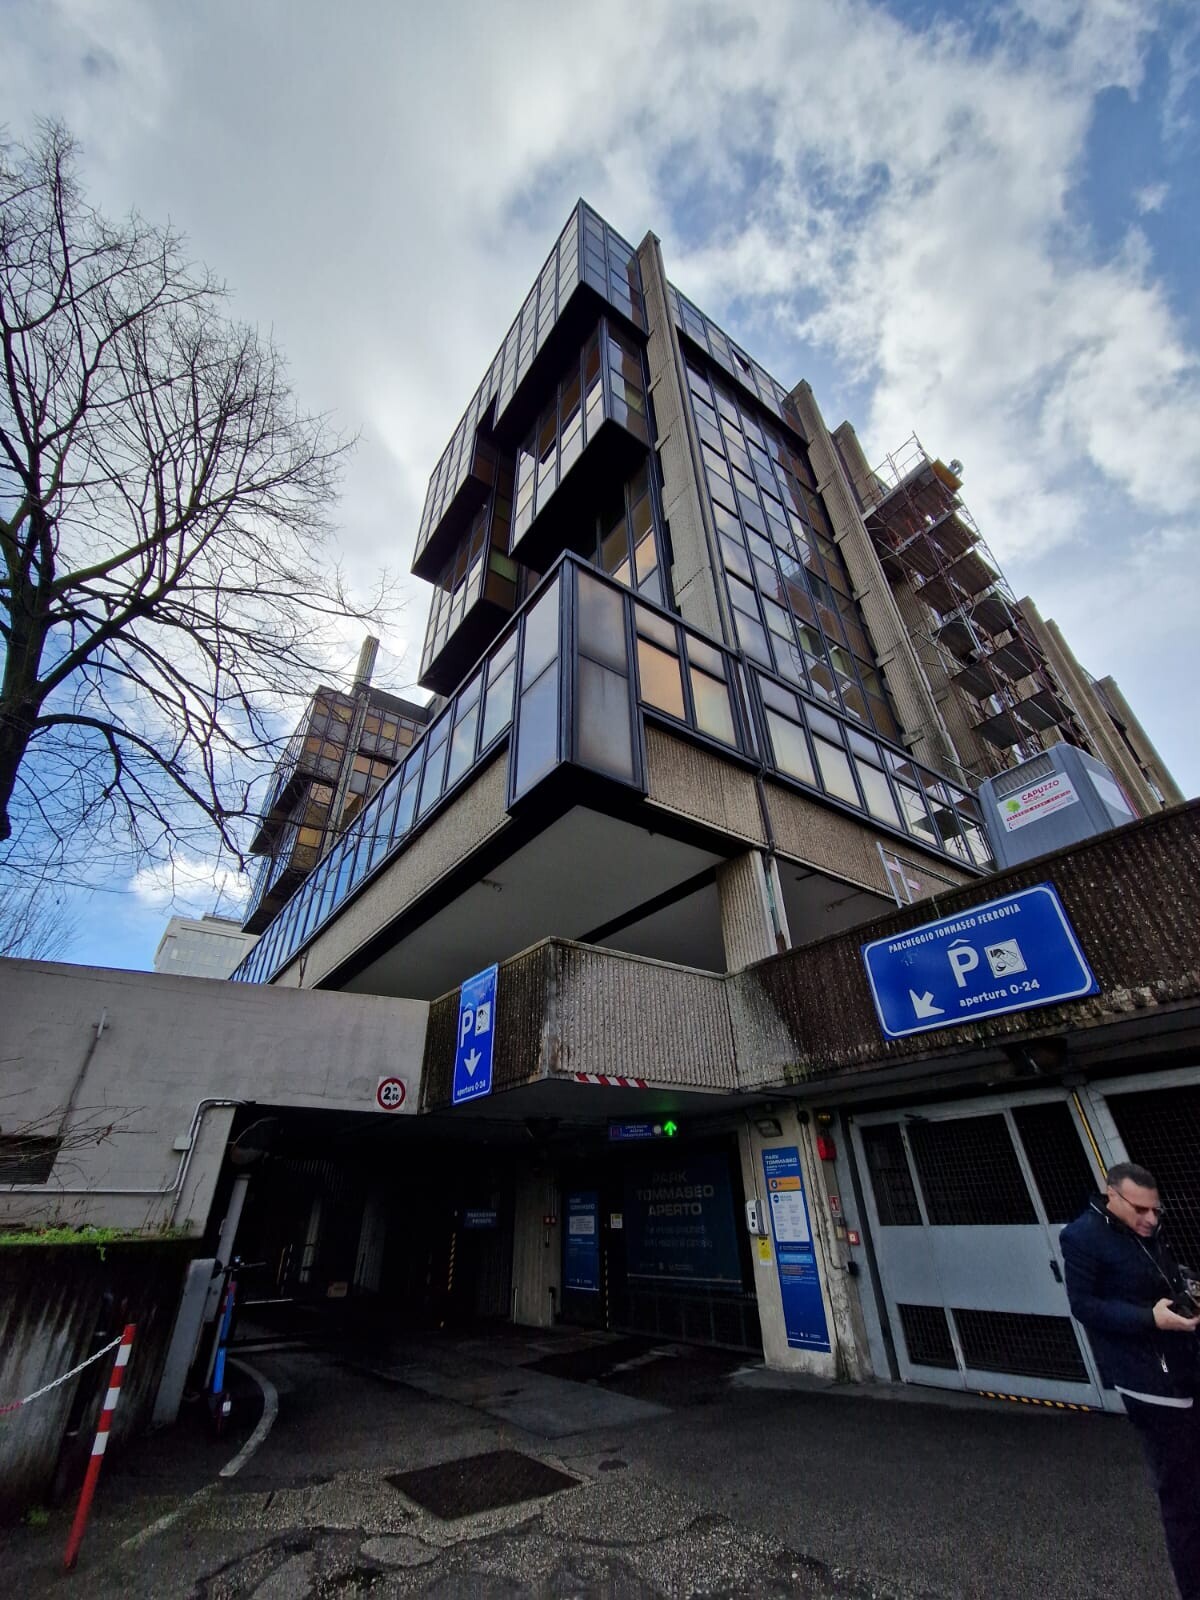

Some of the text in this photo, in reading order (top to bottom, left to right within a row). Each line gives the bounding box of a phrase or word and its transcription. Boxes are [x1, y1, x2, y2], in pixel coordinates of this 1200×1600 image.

[1021, 780, 1060, 801] CAPUZZO
[888, 903, 1021, 954] PARCHEGGIO TOMMASEO FERROVIA
[947, 944, 979, 988] P
[959, 978, 1040, 1008] apertura 0-24
[460, 1008, 474, 1049] P
[634, 1184, 715, 1201] TOMMASEO
[648, 1202, 703, 1217] APERTO
